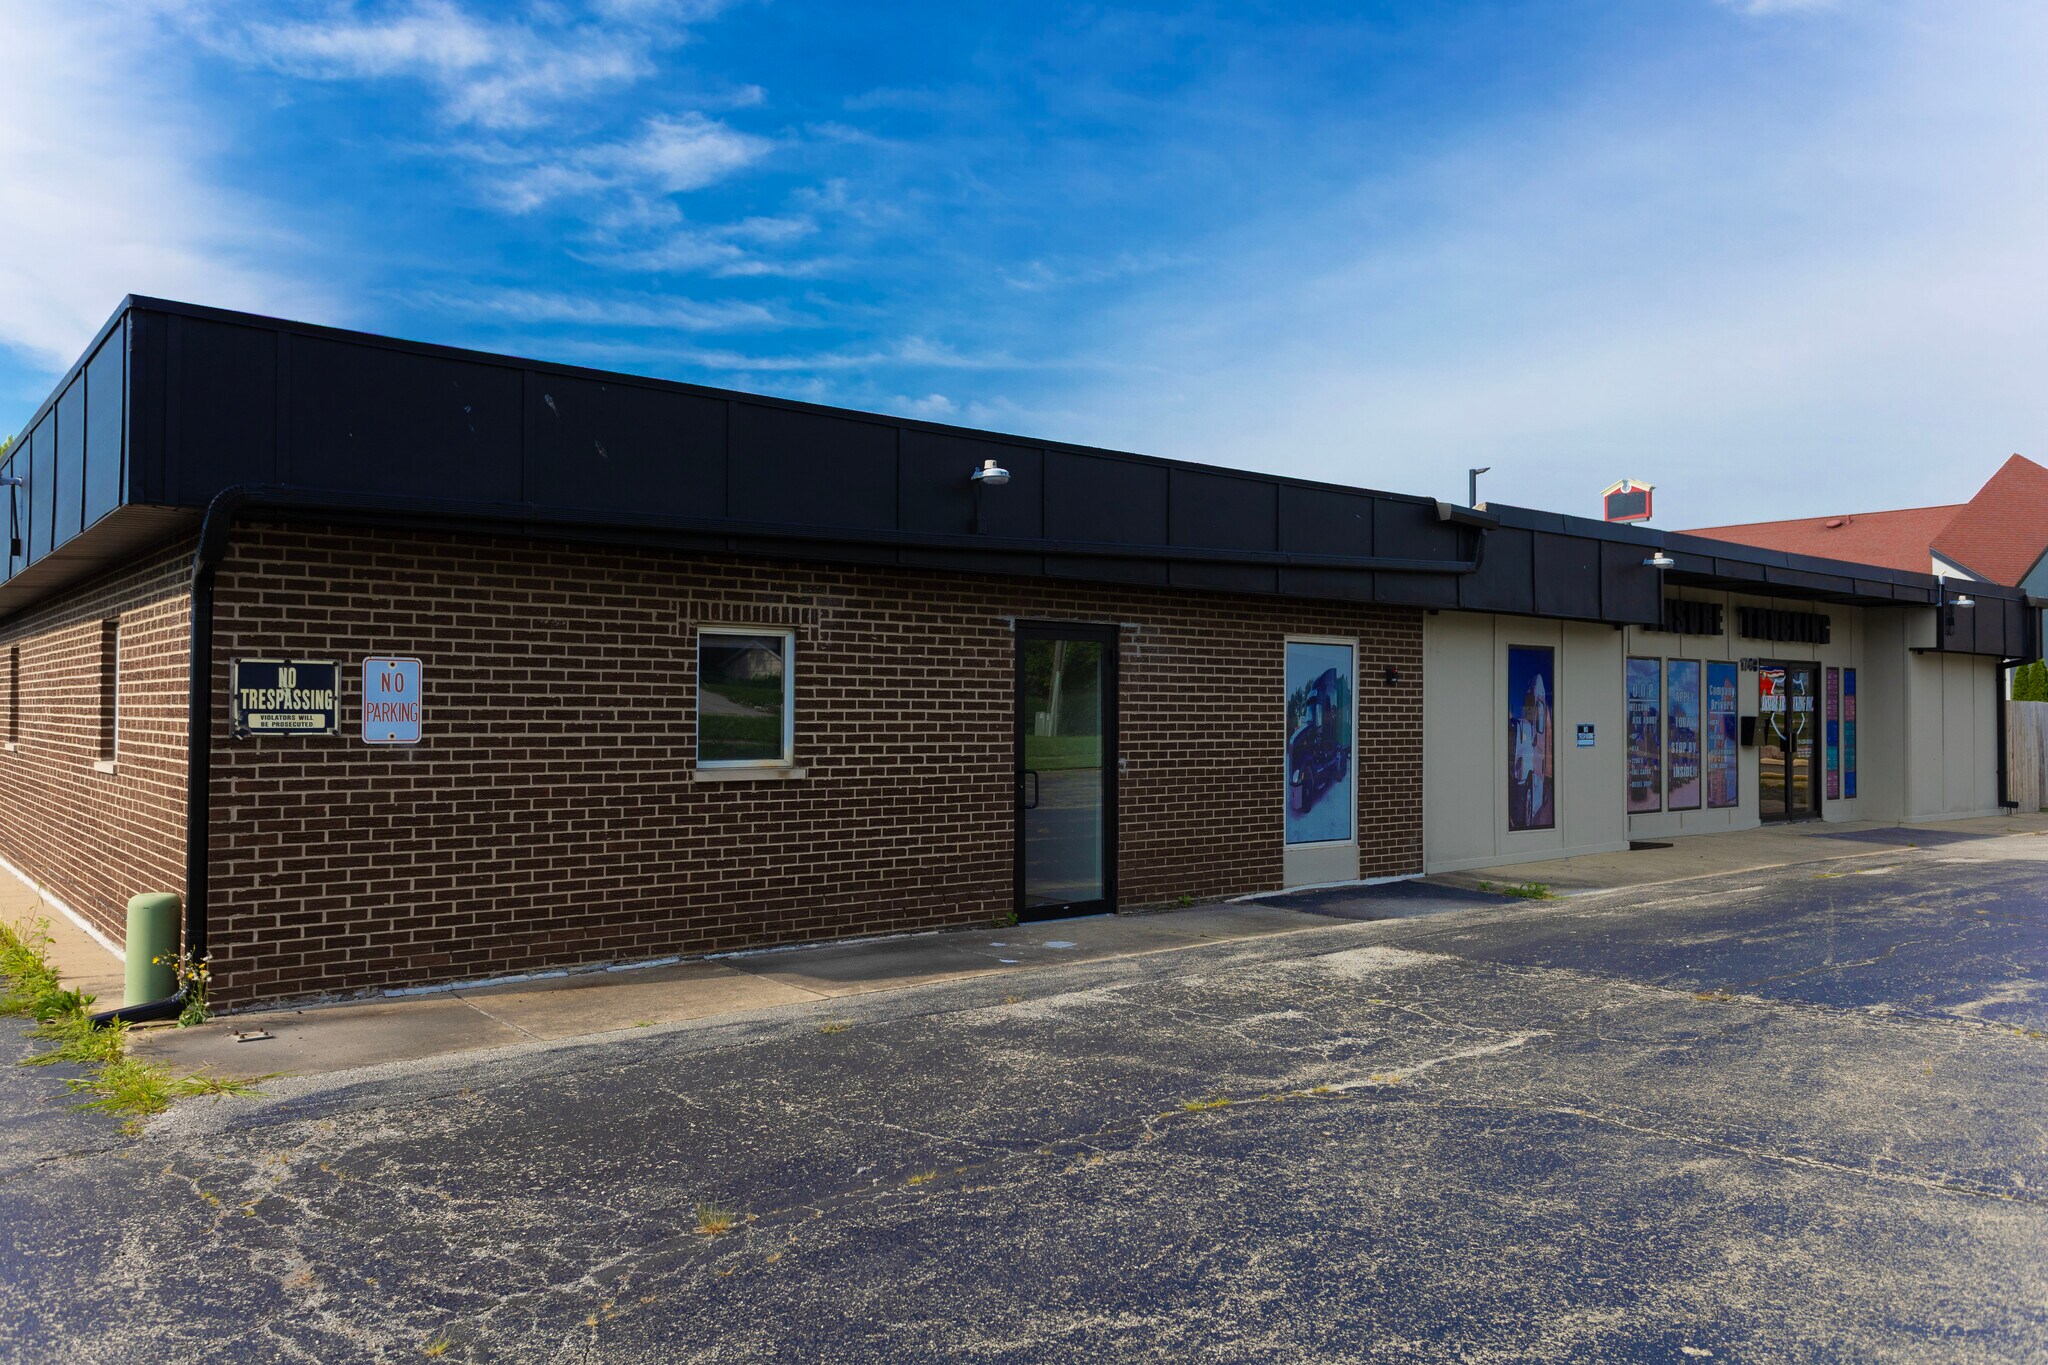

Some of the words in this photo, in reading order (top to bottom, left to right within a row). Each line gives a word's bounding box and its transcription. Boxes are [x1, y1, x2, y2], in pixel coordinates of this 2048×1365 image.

[1736, 606, 1831, 645] TRUCKING
[278, 667, 297, 688] NO
[381, 672, 404, 693] NO
[240, 688, 333, 710] TRESPASSING
[1710, 685, 1735, 697] Company
[366, 702, 418, 722] PARKING
[1629, 703, 1650, 711] WELCOME
[1711, 700, 1734, 710] Drivers
[1671, 741, 1687, 753] STOP
[1687, 742, 1697, 753] BY
